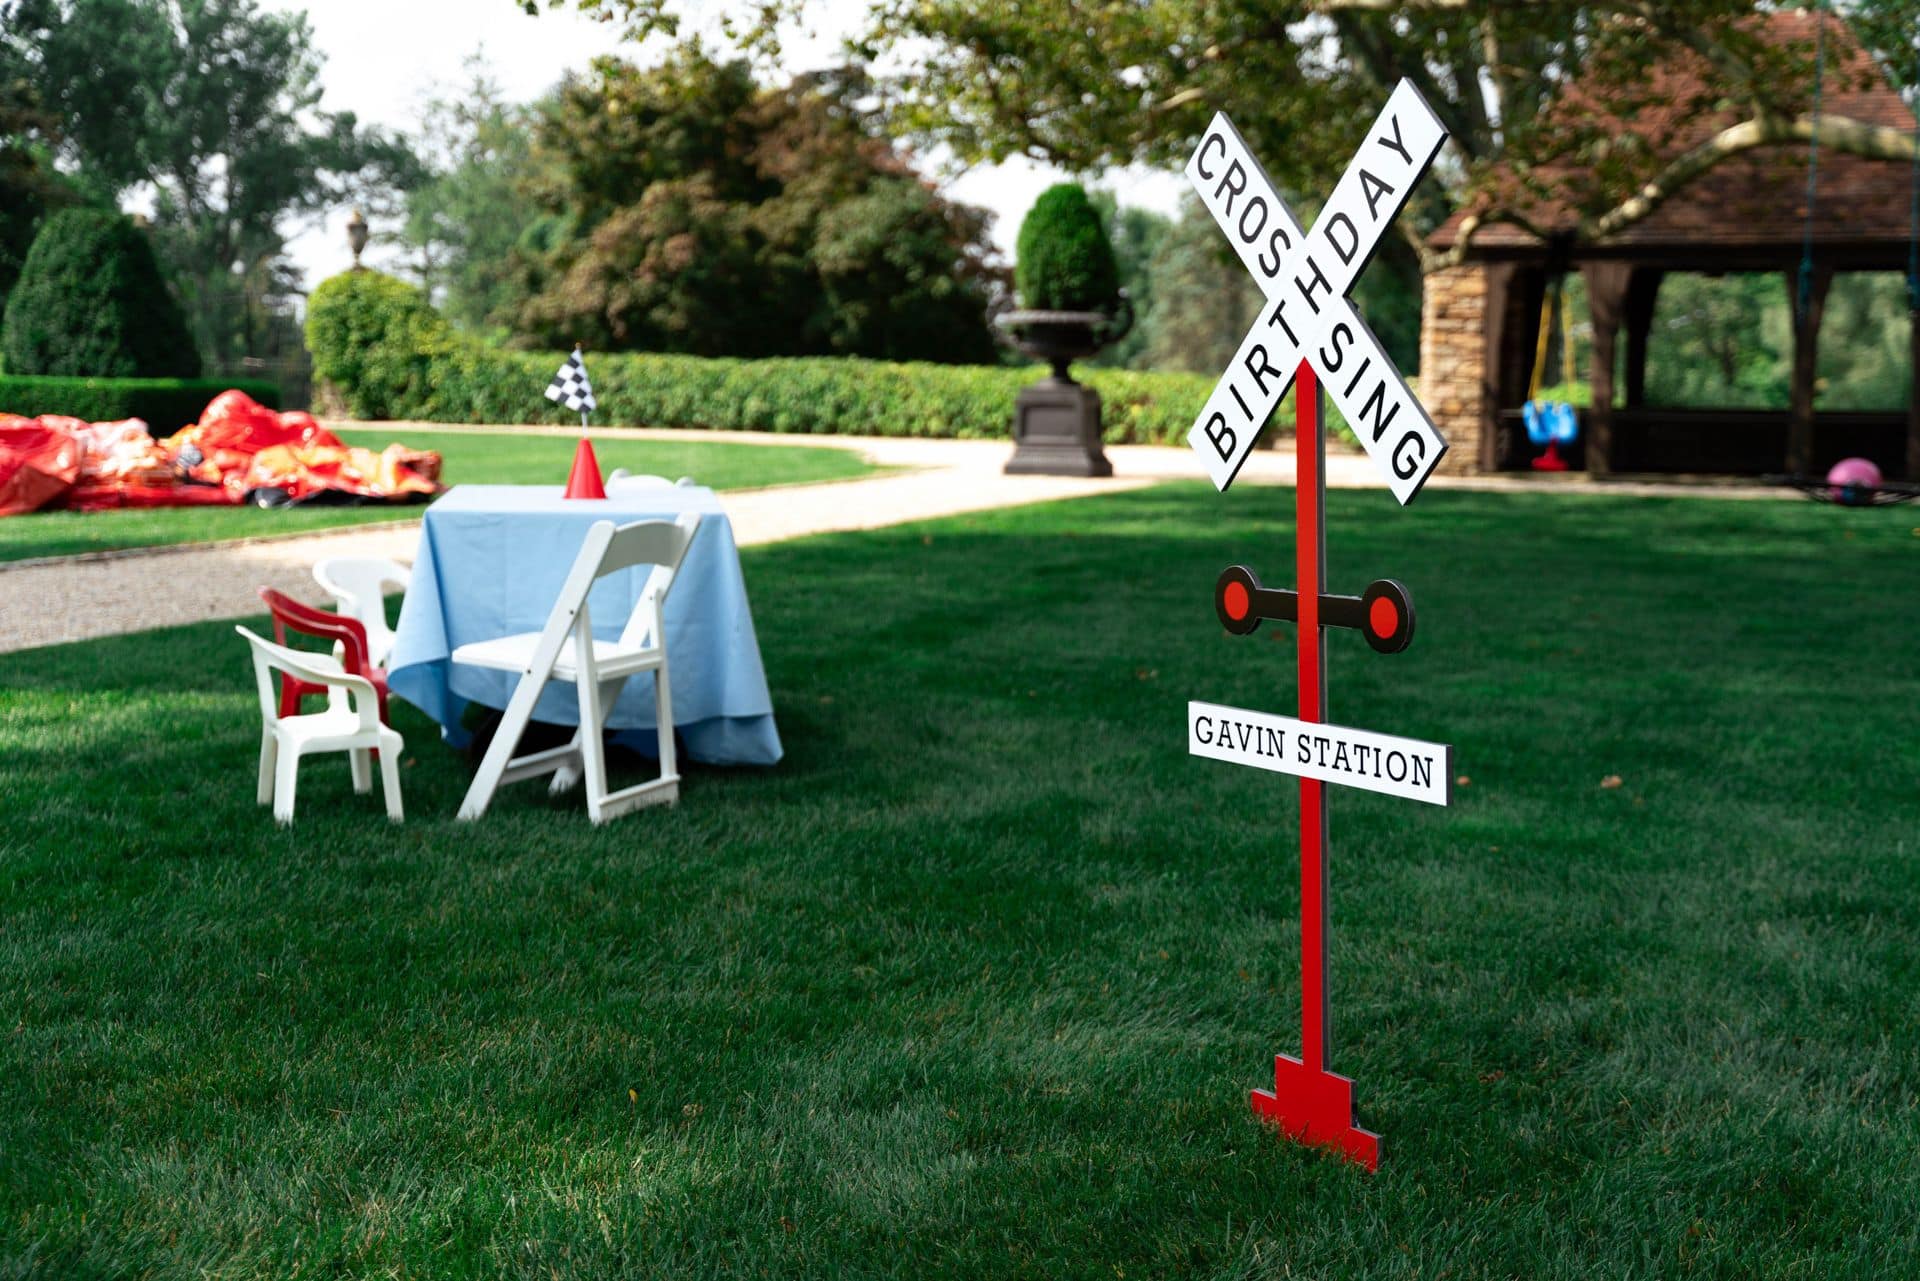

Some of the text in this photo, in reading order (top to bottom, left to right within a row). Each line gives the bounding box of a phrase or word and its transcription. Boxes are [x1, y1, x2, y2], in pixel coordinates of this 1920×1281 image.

[1204, 113, 1413, 463] BIRTHDAY
[1195, 716, 1433, 788] GAVIN STATION
